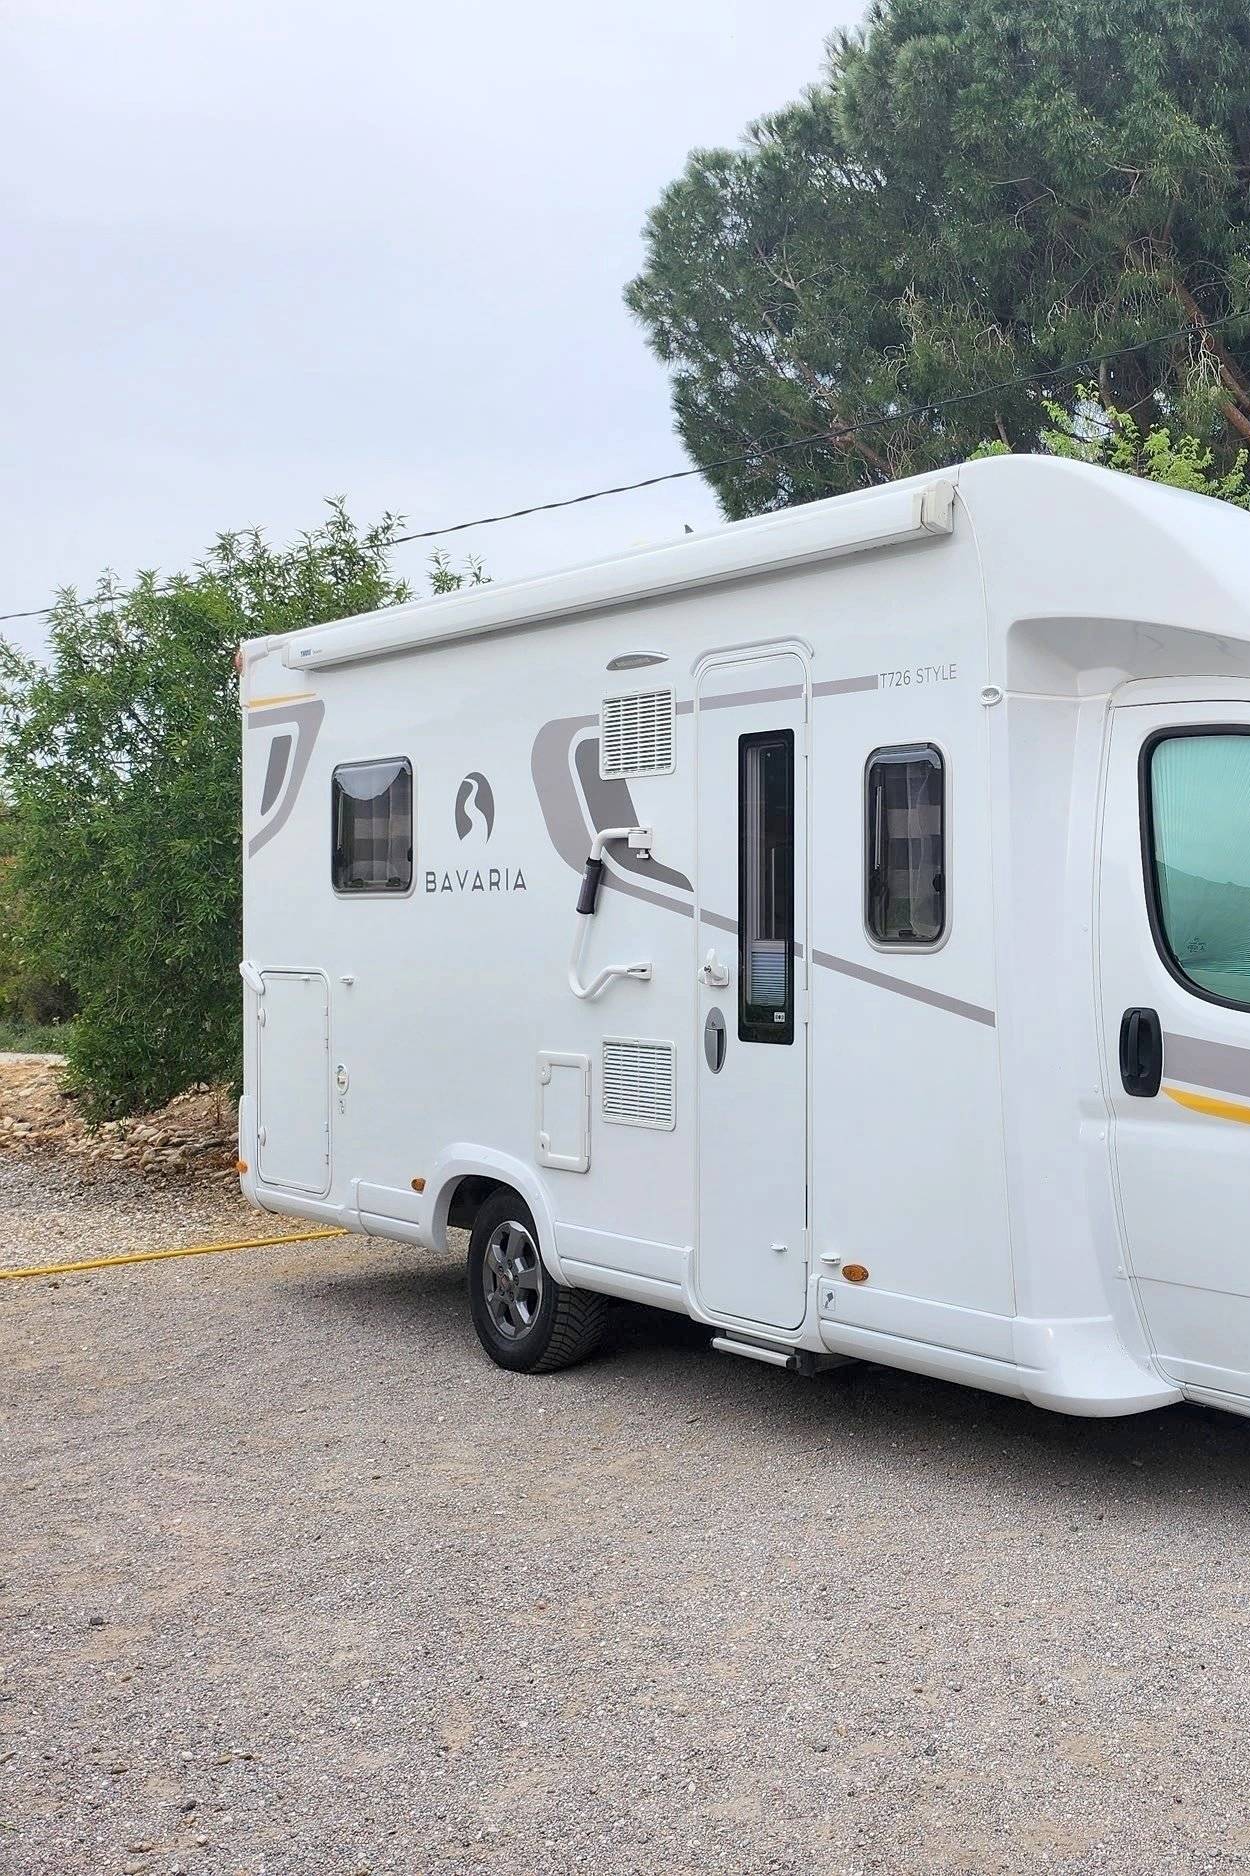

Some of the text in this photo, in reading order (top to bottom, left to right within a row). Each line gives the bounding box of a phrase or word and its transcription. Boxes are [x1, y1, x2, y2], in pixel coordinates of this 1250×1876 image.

[880, 664, 957, 688] T726 STYLE
[425, 868, 527, 893] BAVARIA
